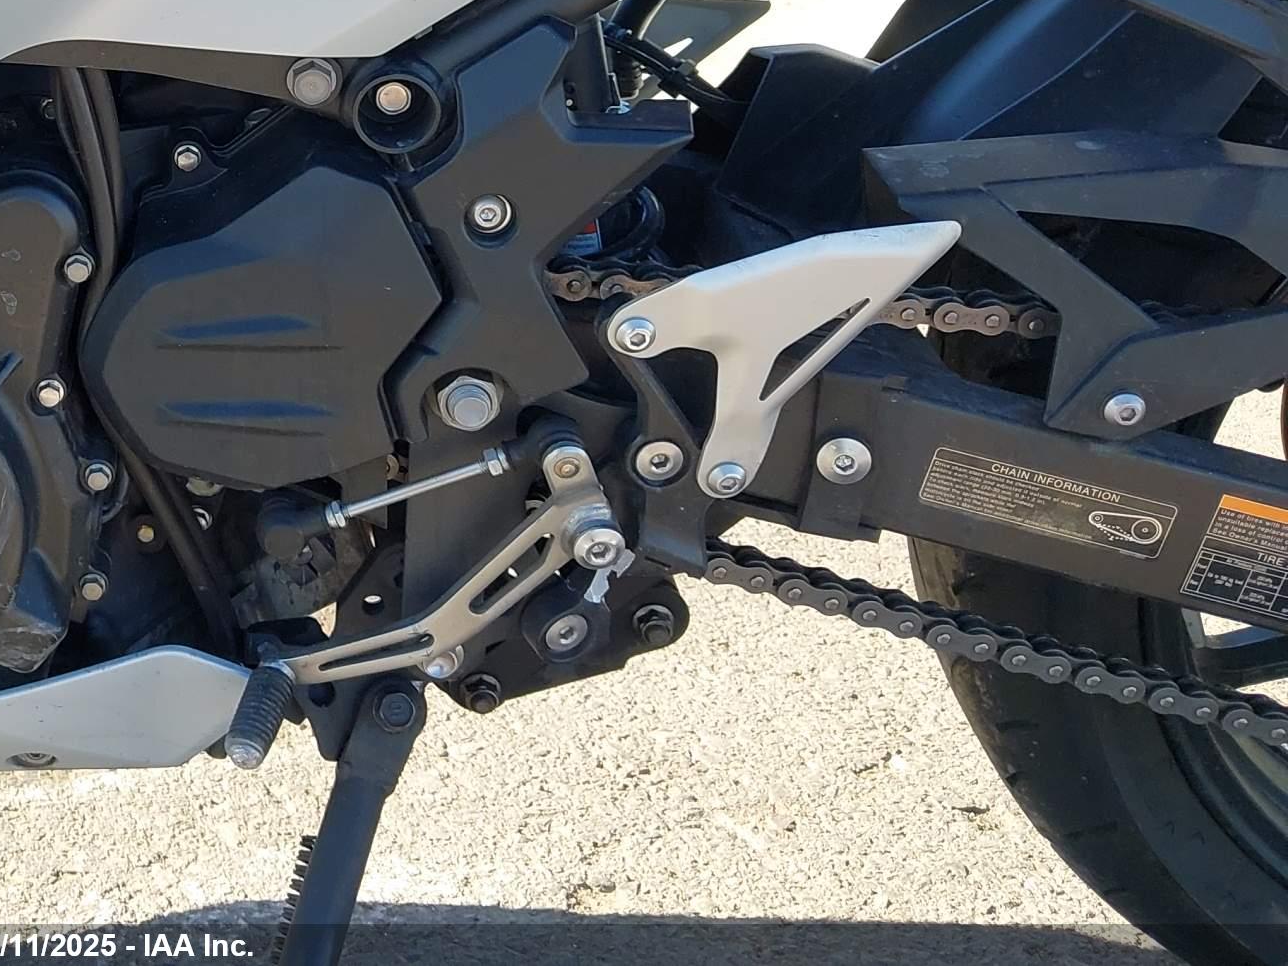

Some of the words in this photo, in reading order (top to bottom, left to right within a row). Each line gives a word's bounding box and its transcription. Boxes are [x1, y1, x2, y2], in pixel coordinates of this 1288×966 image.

[992, 463, 1031, 481] CHAIN
[1033, 473, 1121, 504] INFORMATION
[1221, 509, 1235, 517] Use
[1257, 551, 1287, 567] TIRE
